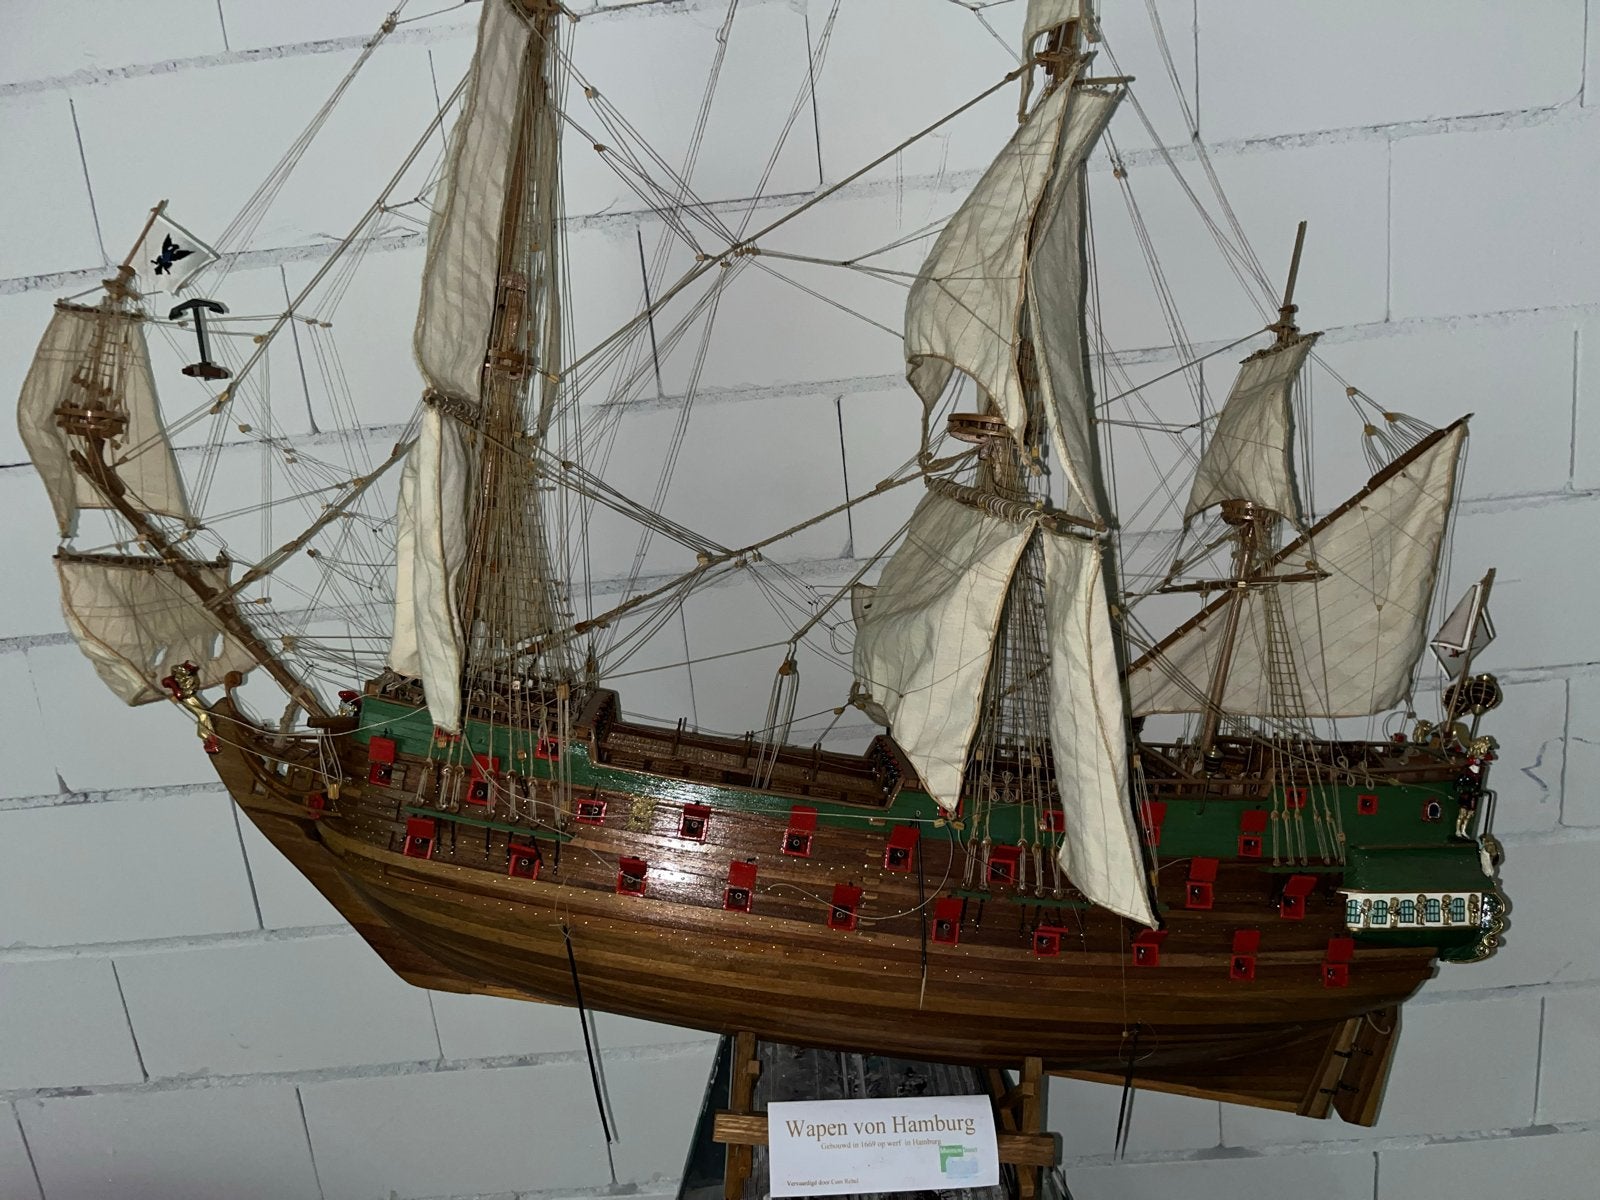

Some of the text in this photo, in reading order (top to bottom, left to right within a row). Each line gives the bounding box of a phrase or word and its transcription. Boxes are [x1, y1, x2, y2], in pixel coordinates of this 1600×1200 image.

[786, 1114, 975, 1141] Wapen von Hamburg
[821, 1141, 851, 1150] Gebouwd
[852, 1140, 859, 1148] in
[877, 1140, 886, 1149] op
[887, 1138, 902, 1147] werf
[912, 1137, 942, 1147] Hamburg
